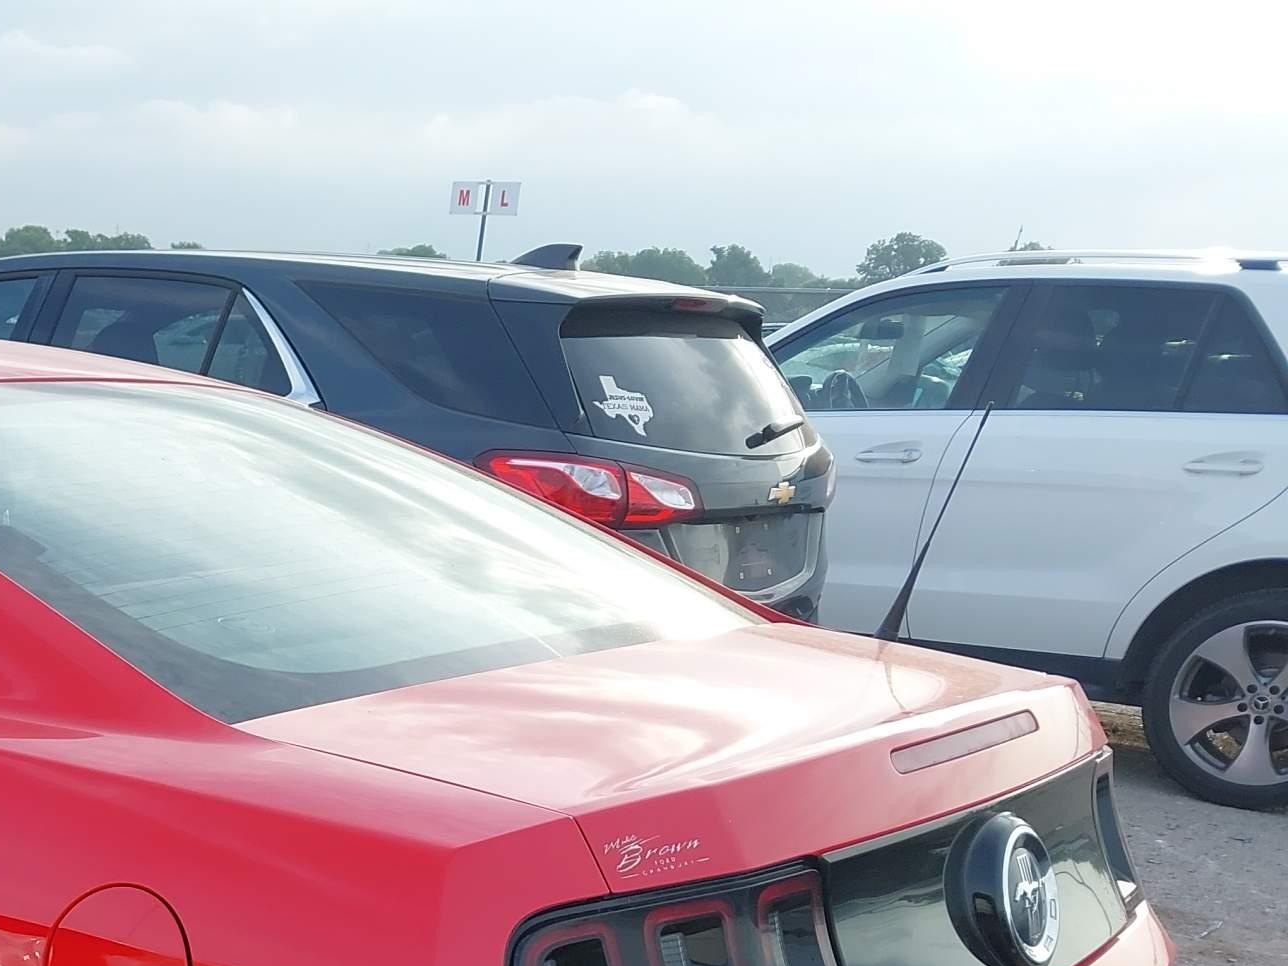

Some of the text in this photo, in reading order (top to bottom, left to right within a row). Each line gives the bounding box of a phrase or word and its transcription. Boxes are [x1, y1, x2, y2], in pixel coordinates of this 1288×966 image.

[458, 190, 470, 206] M
[500, 190, 508, 207] L
[601, 402, 629, 410] TEXAS
[616, 841, 700, 873] Brown
